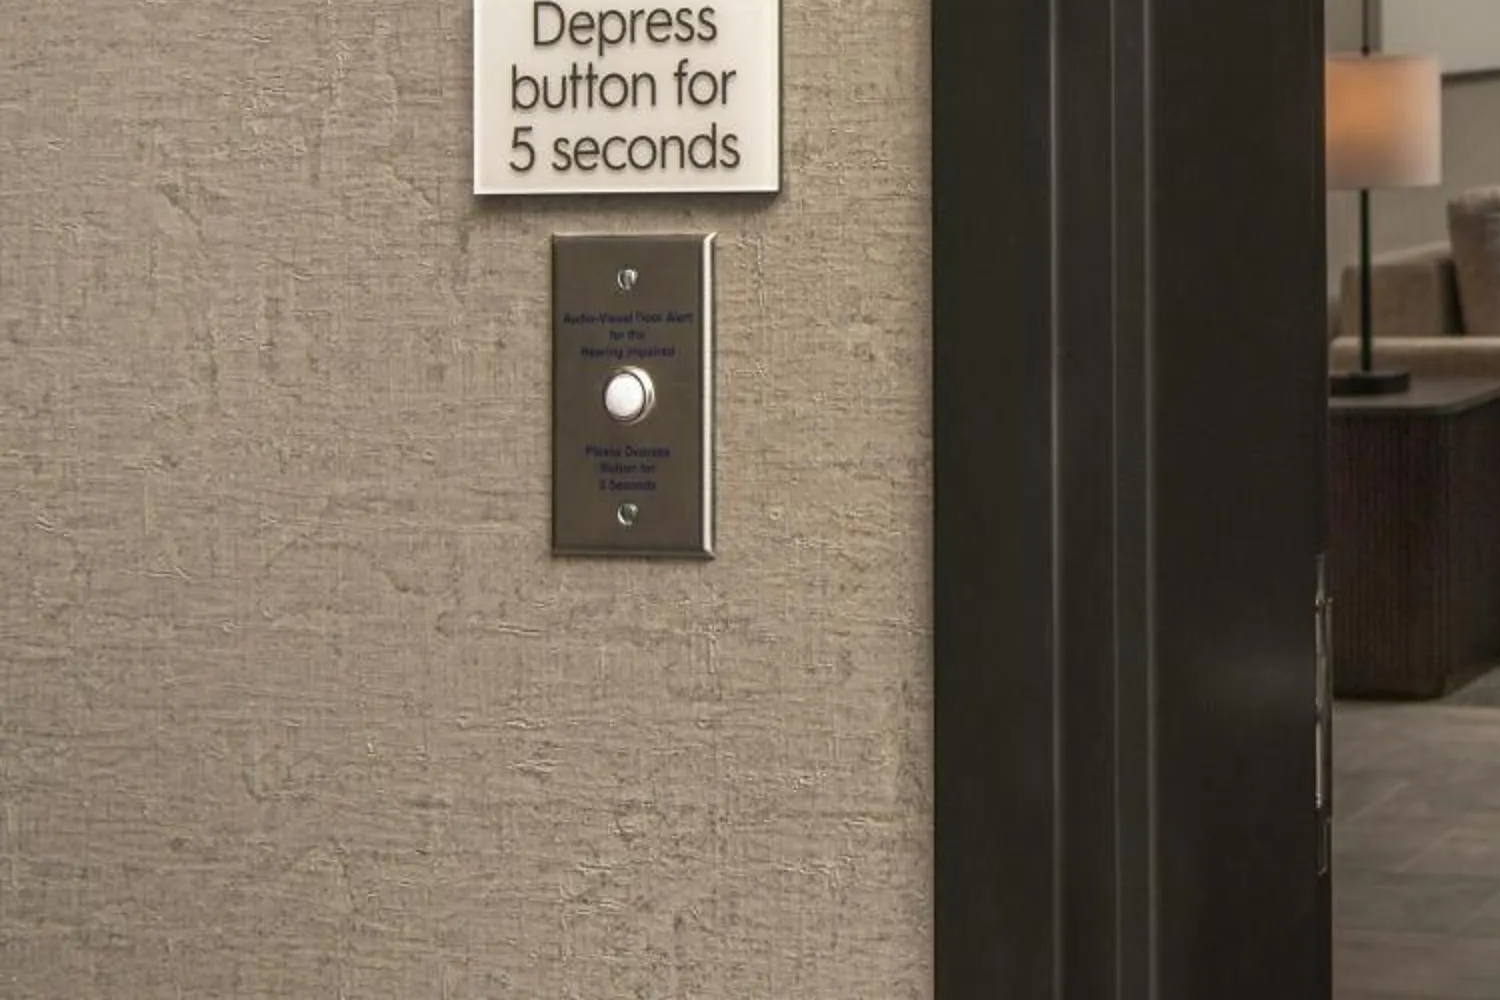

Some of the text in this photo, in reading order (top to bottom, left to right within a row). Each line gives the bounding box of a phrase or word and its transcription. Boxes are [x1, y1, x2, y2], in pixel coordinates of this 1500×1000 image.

[533, 0, 718, 56] Depress
[511, 58, 737, 110] button for
[509, 122, 741, 172] 5 seconds
